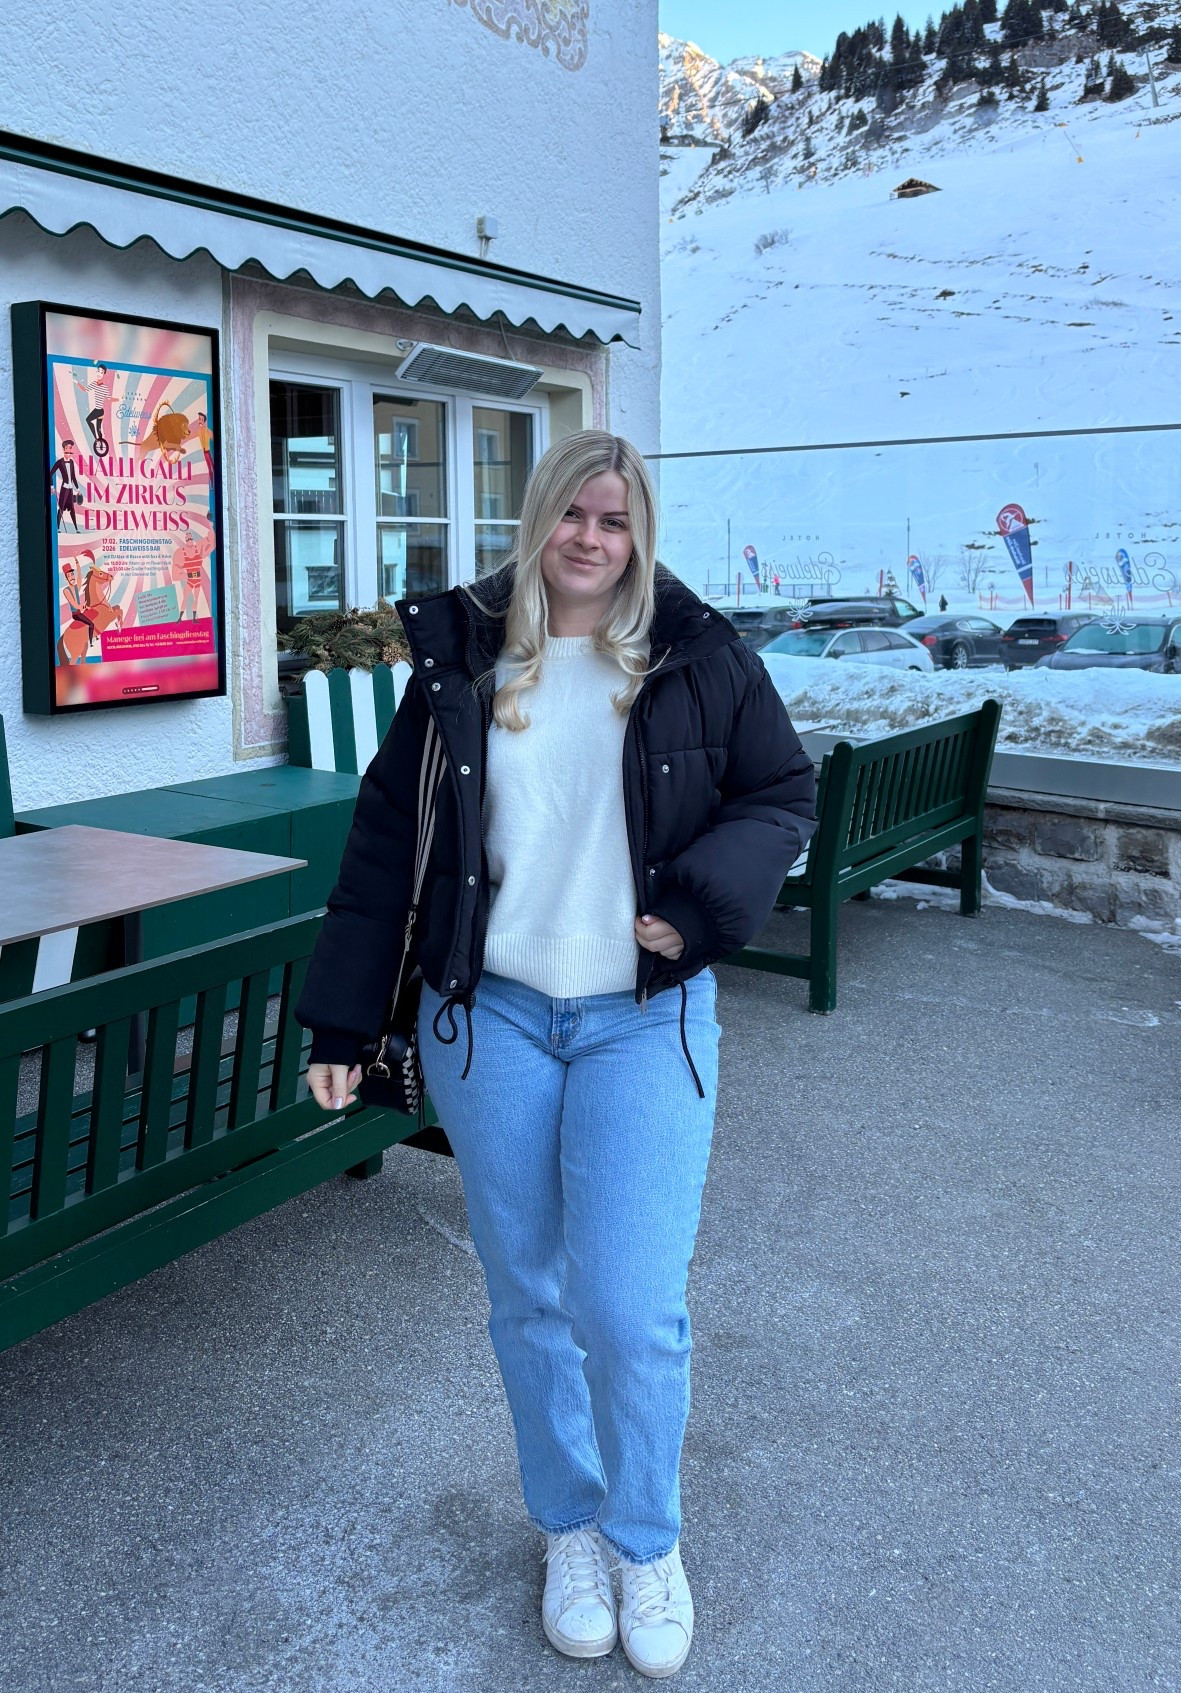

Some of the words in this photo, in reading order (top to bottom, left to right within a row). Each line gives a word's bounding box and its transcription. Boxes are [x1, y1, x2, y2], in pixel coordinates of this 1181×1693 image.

[79, 455, 134, 478] HALLI
[140, 458, 192, 480] GALLI
[87, 482, 110, 504] IM
[115, 484, 187, 506] ZIRKUS
[84, 509, 190, 532] EDELWEISS
[106, 635, 133, 644] Manege
[133, 633, 145, 642] frei
[157, 630, 210, 640] Faschingdienstag
